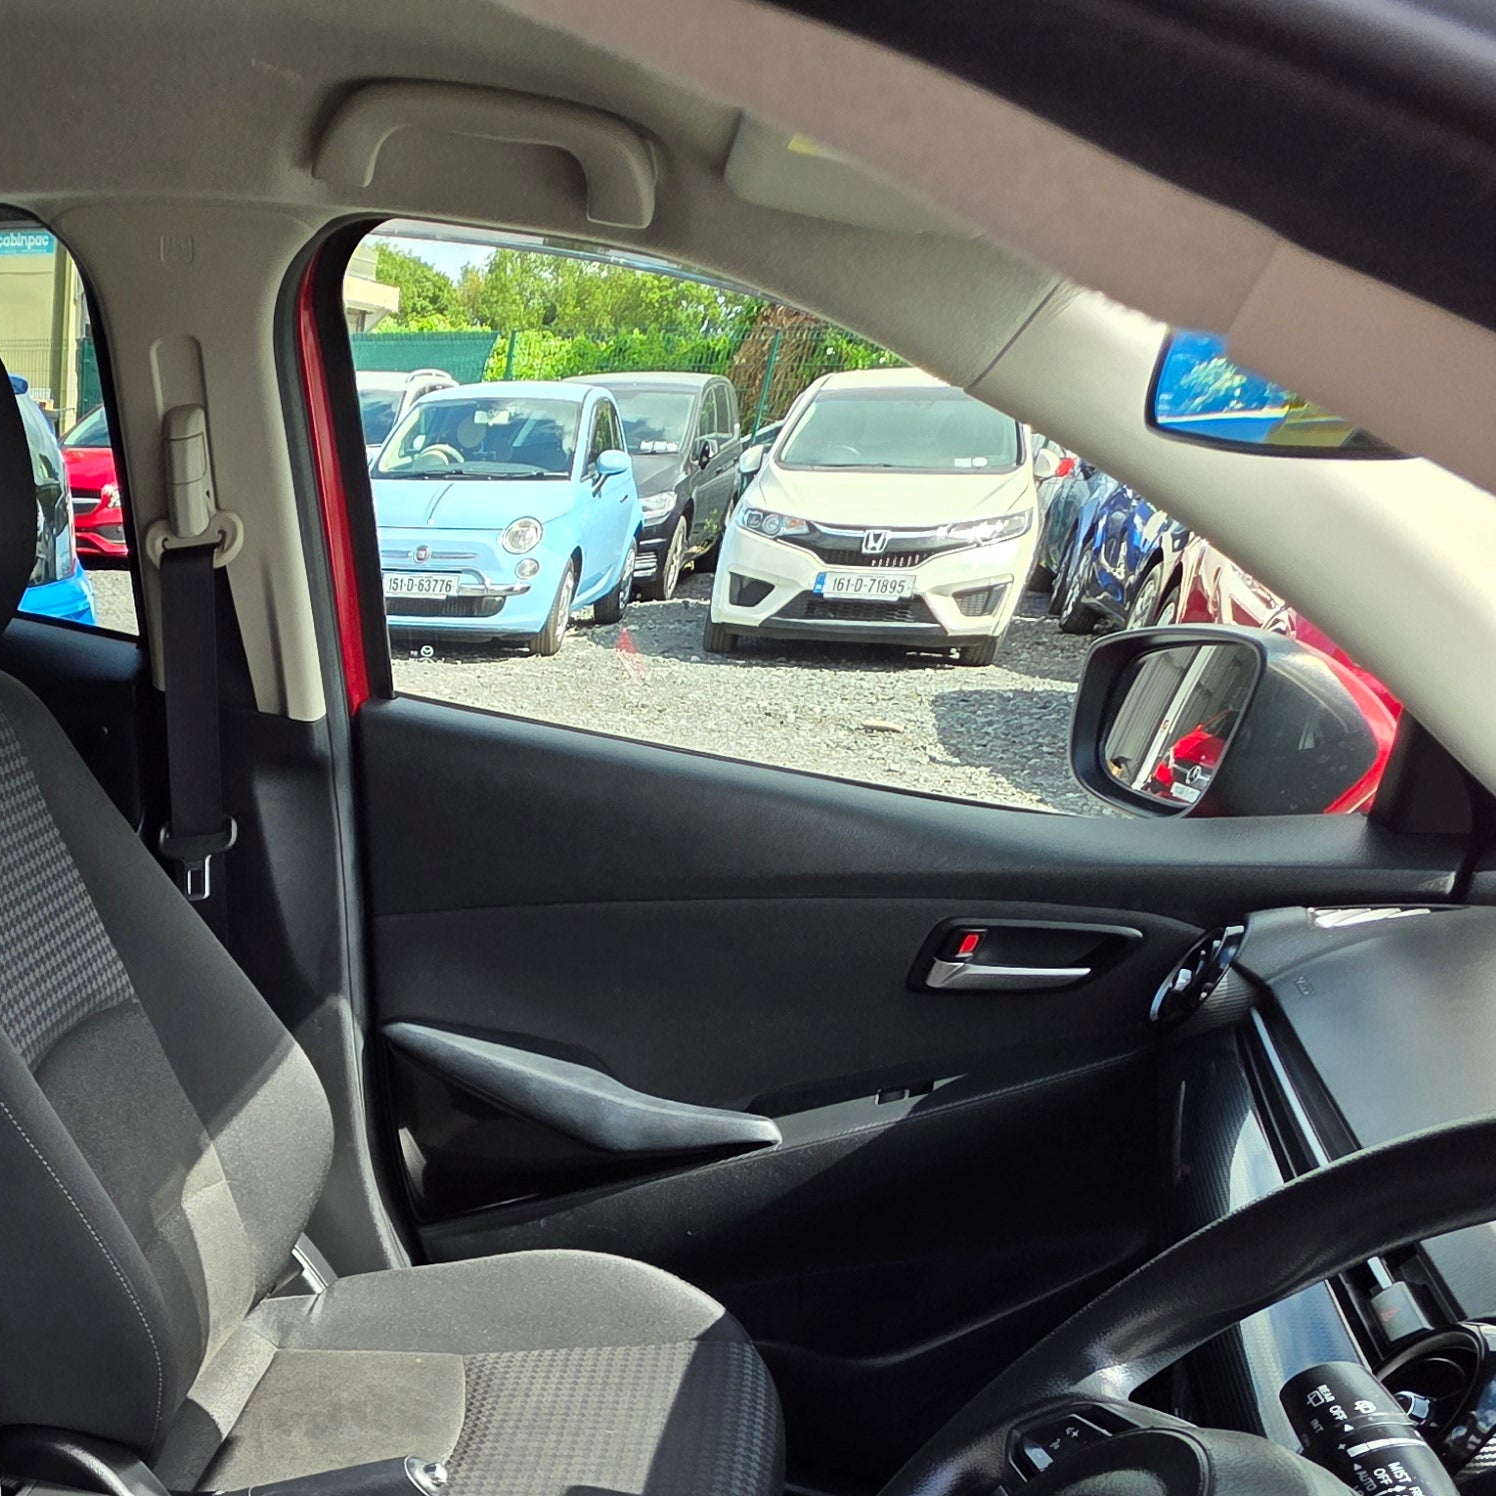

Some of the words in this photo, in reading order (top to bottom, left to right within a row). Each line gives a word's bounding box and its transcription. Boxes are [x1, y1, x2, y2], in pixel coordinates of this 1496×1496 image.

[832, 577, 906, 594] 161-D-71895
[1317, 1384, 1336, 1403] REAR
[1329, 1404, 1348, 1421] OFF
[1310, 1418, 1324, 1434] INT
[1357, 1470, 1377, 1492] AUTO
[1373, 1467, 1393, 1485] OFF
[1388, 1461, 1412, 1483] MIST
